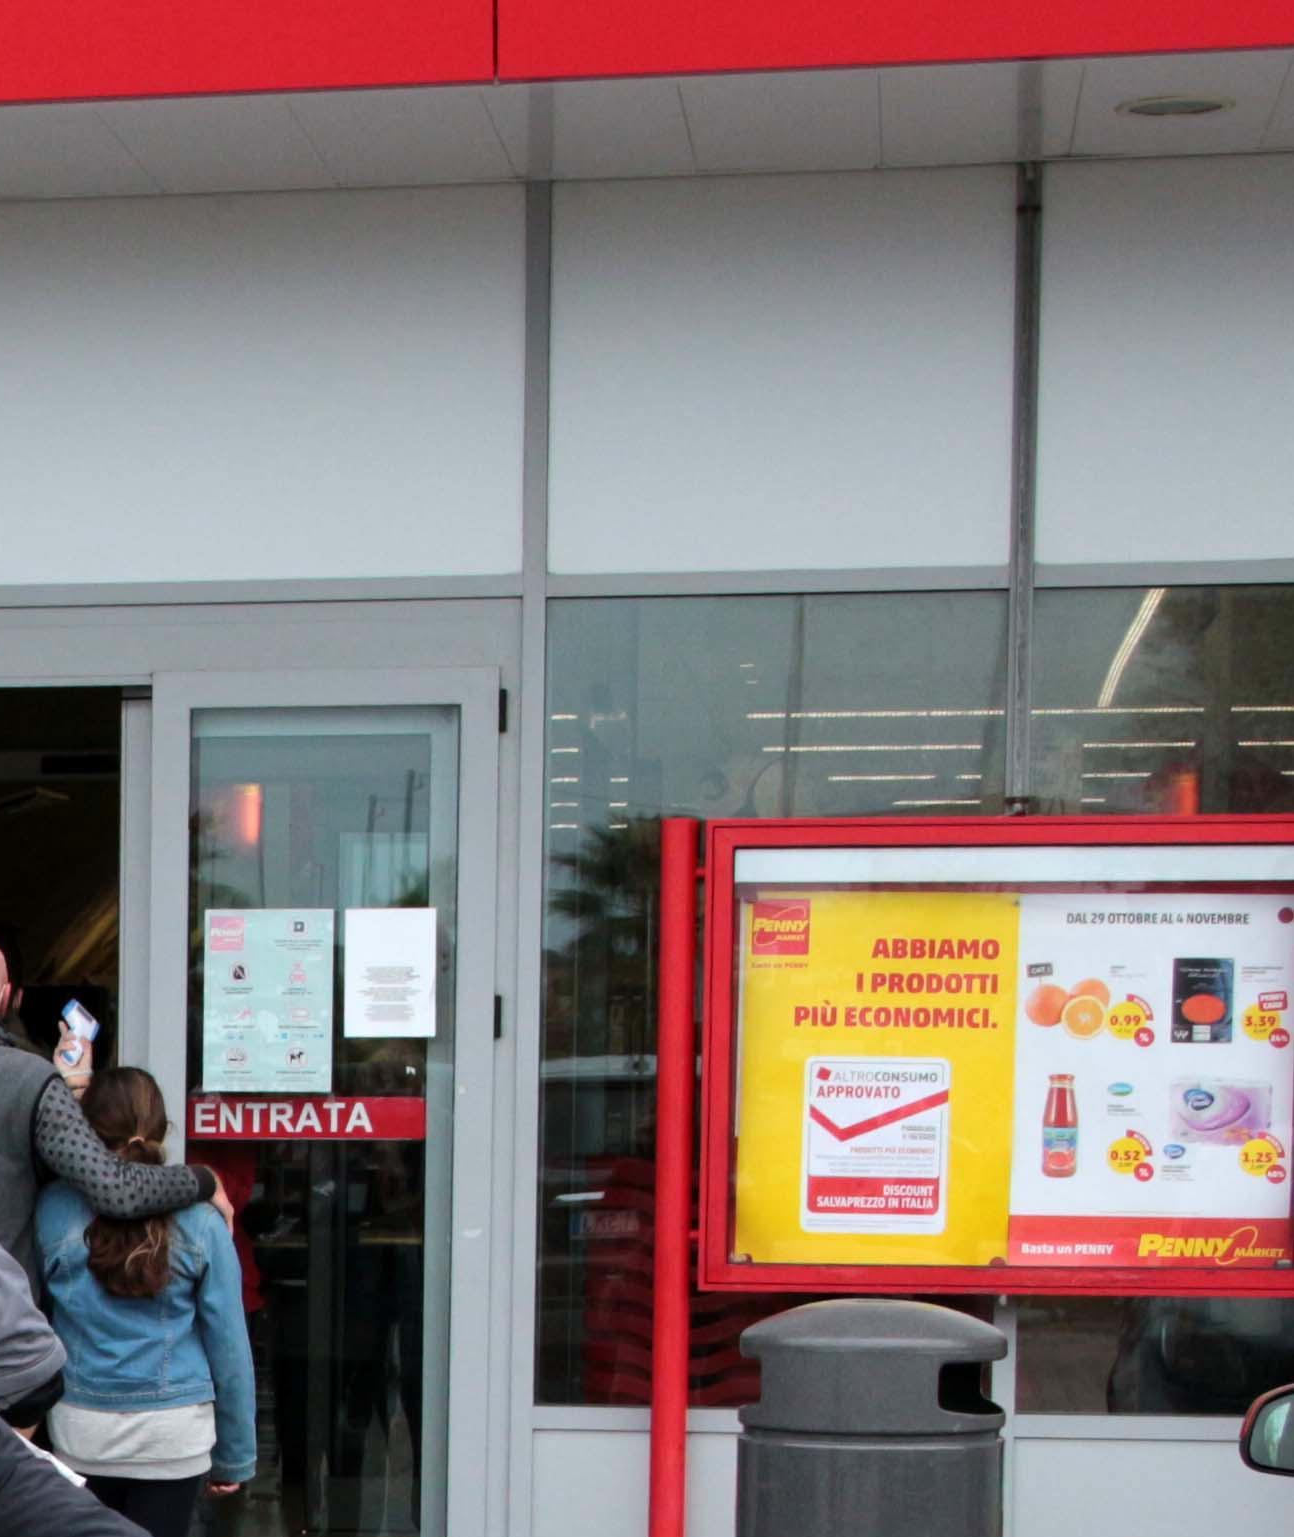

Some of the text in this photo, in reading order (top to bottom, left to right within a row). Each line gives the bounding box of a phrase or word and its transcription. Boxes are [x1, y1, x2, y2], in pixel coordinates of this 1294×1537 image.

[752, 917, 809, 933] PENNY
[1066, 913, 1250, 926] DAL 29 OTTOBRE AL 4 NOVEMBRE
[871, 938, 1000, 960] ABBIAMO
[855, 972, 999, 994] I PRODOTTI
[793, 1000, 998, 1028] PIÙ ECONOMICI.
[1110, 1015, 1141, 1027] 0.99
[1245, 1016, 1277, 1027] 3.39
[833, 1069, 938, 1083] ALTROCONSUMO
[816, 1085, 901, 1099] APPROVATO
[194, 1102, 373, 1134] ENTRATA
[1110, 1150, 1141, 1161] 0.52
[883, 1185, 935, 1197] DISCOUNT
[816, 1195, 934, 1210] SALVAPREZZO IN ITALIA
[1020, 1242, 1115, 1256] Basta un PENNY
[1137, 1232, 1285, 1259] PENNY MARKET
